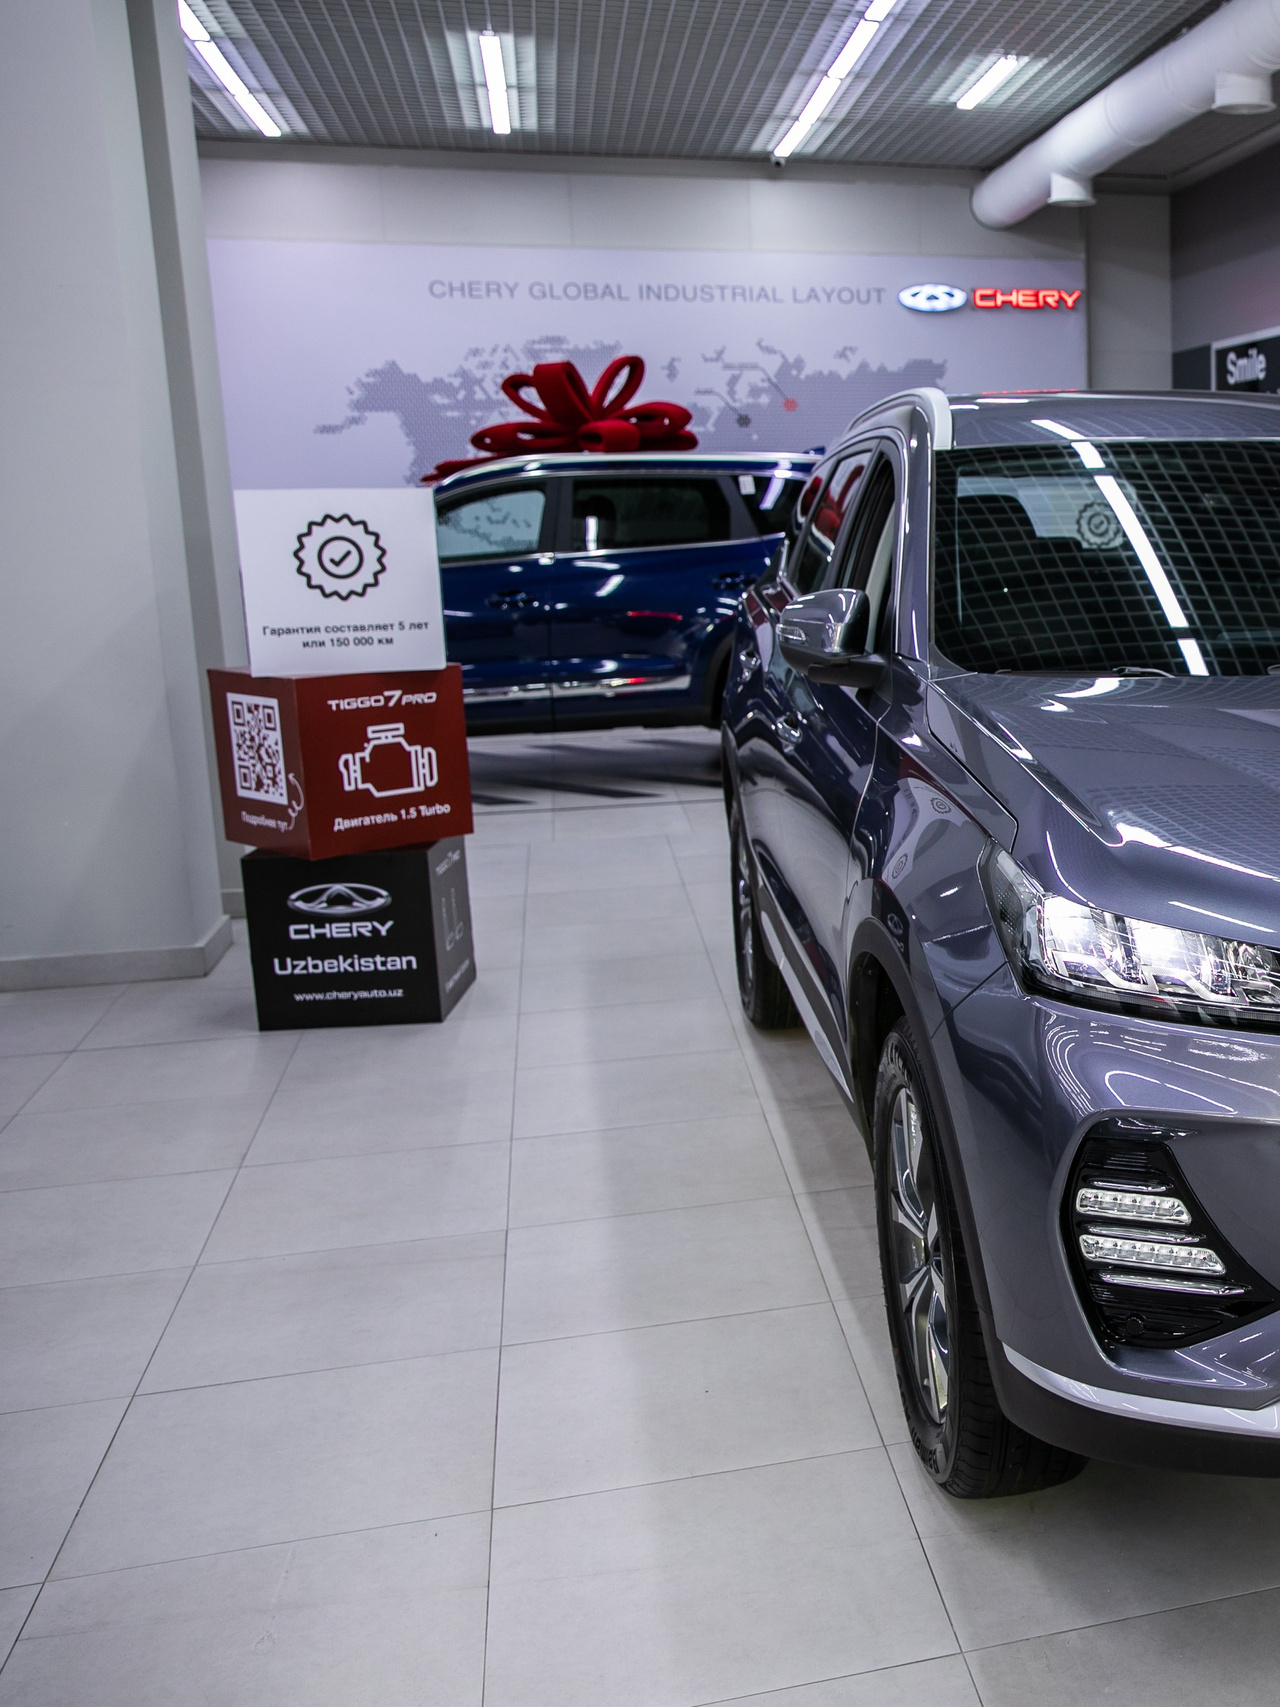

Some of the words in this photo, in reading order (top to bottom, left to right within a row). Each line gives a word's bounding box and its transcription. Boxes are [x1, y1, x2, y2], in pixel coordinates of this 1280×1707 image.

[428, 278, 520, 300] CHERY
[527, 280, 631, 301] GLOBAL
[637, 282, 784, 304] INDUSTRIAL
[791, 285, 887, 306] LAYOUT
[973, 287, 1082, 309] CHERY
[1226, 347, 1267, 386] Smile
[262, 625, 321, 638] Гарантия
[324, 623, 395, 634] составляет
[398, 621, 405, 631] 5
[408, 621, 430, 631] лет
[302, 640, 326, 649] или
[330, 637, 350, 648] 150
[353, 636, 375, 647] 000
[377, 636, 395, 646] км
[326, 695, 385, 712] TIGGO
[401, 691, 438, 706] PRO
[333, 812, 398, 833] Двигатель
[399, 806, 418, 821] 1.5
[418, 803, 452, 818] Turbo
[288, 919, 395, 940] CHERY
[273, 953, 418, 976] Uzbekistan
[293, 988, 404, 1002] www.cheryauto.uz
